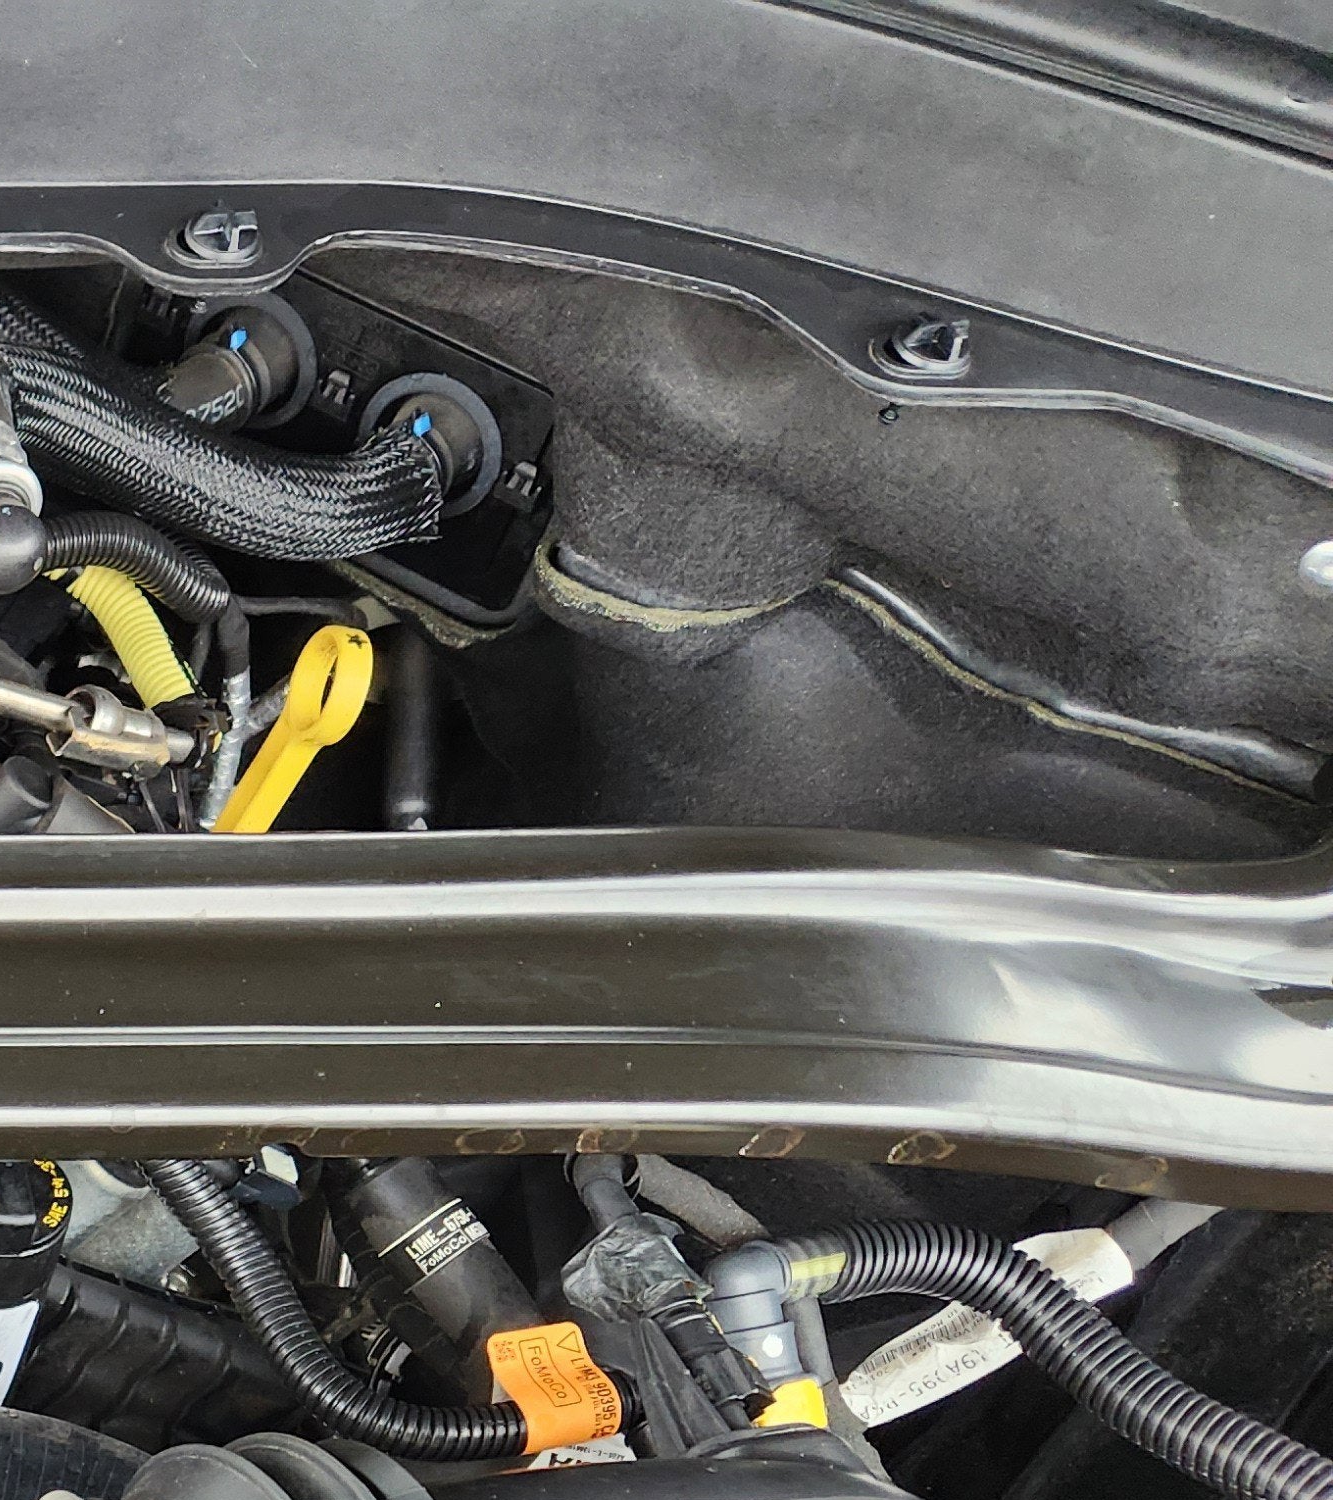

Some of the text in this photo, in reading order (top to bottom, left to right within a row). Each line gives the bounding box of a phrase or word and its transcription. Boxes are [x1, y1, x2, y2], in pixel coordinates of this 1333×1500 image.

[42, 1202, 69, 1228] SAE
[420, 1235, 467, 1272] FoMoCo
[527, 1345, 567, 1399] FoMoCo
[593, 1382, 617, 1420] 9D395
